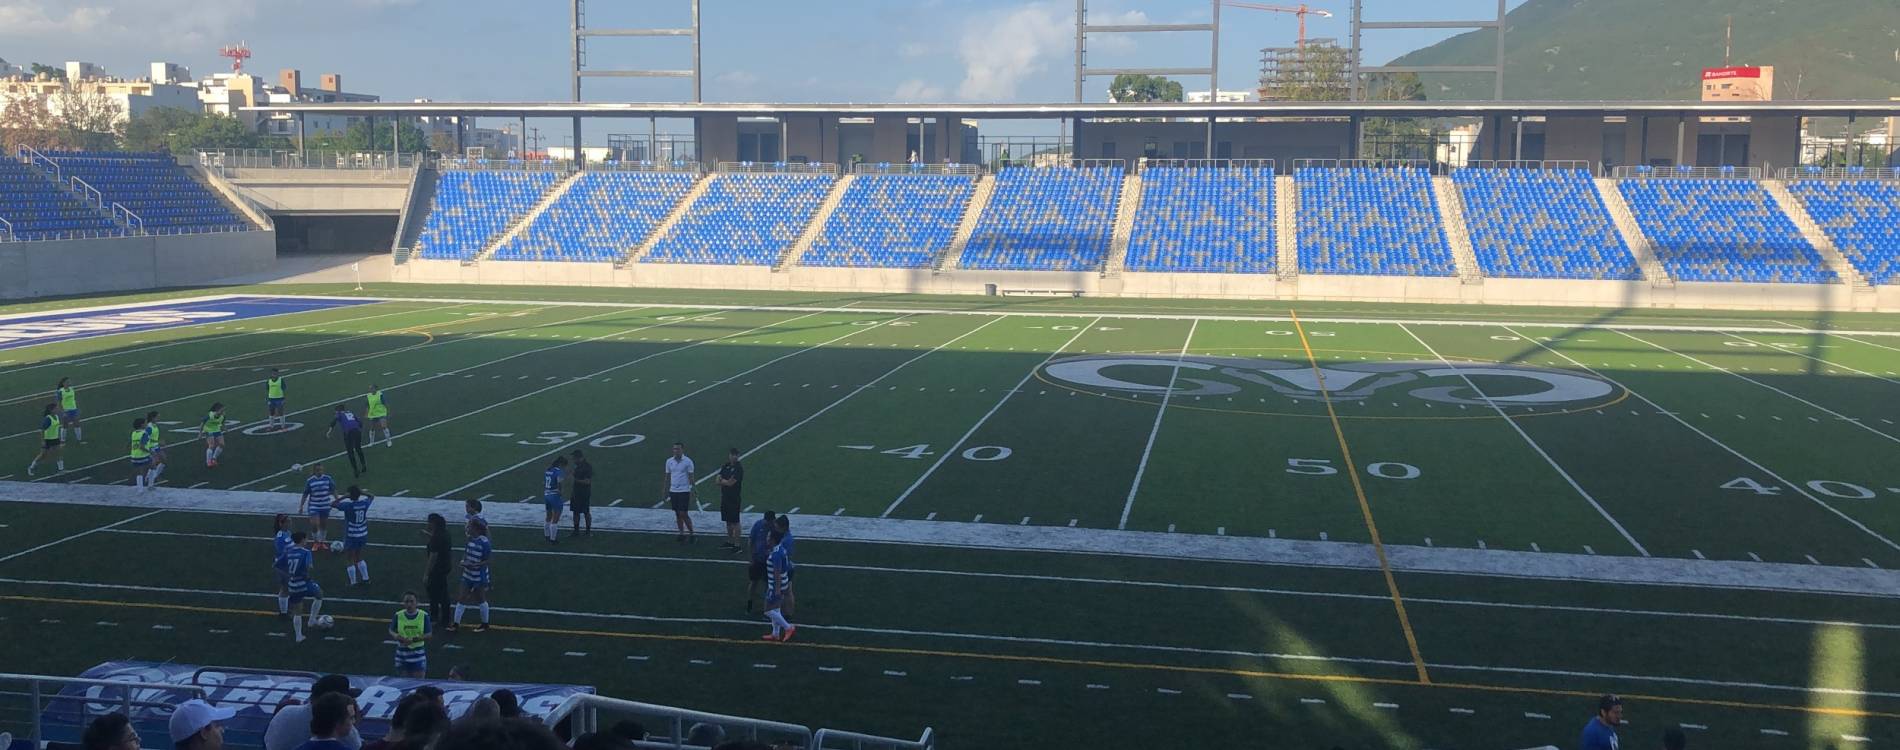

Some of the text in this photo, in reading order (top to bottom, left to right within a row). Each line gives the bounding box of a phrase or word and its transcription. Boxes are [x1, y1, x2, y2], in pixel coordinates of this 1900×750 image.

[517, 430, 646, 448] 30
[879, 444, 1013, 462] 40
[1284, 457, 1421, 480] 50
[1719, 475, 1877, 499] 40
